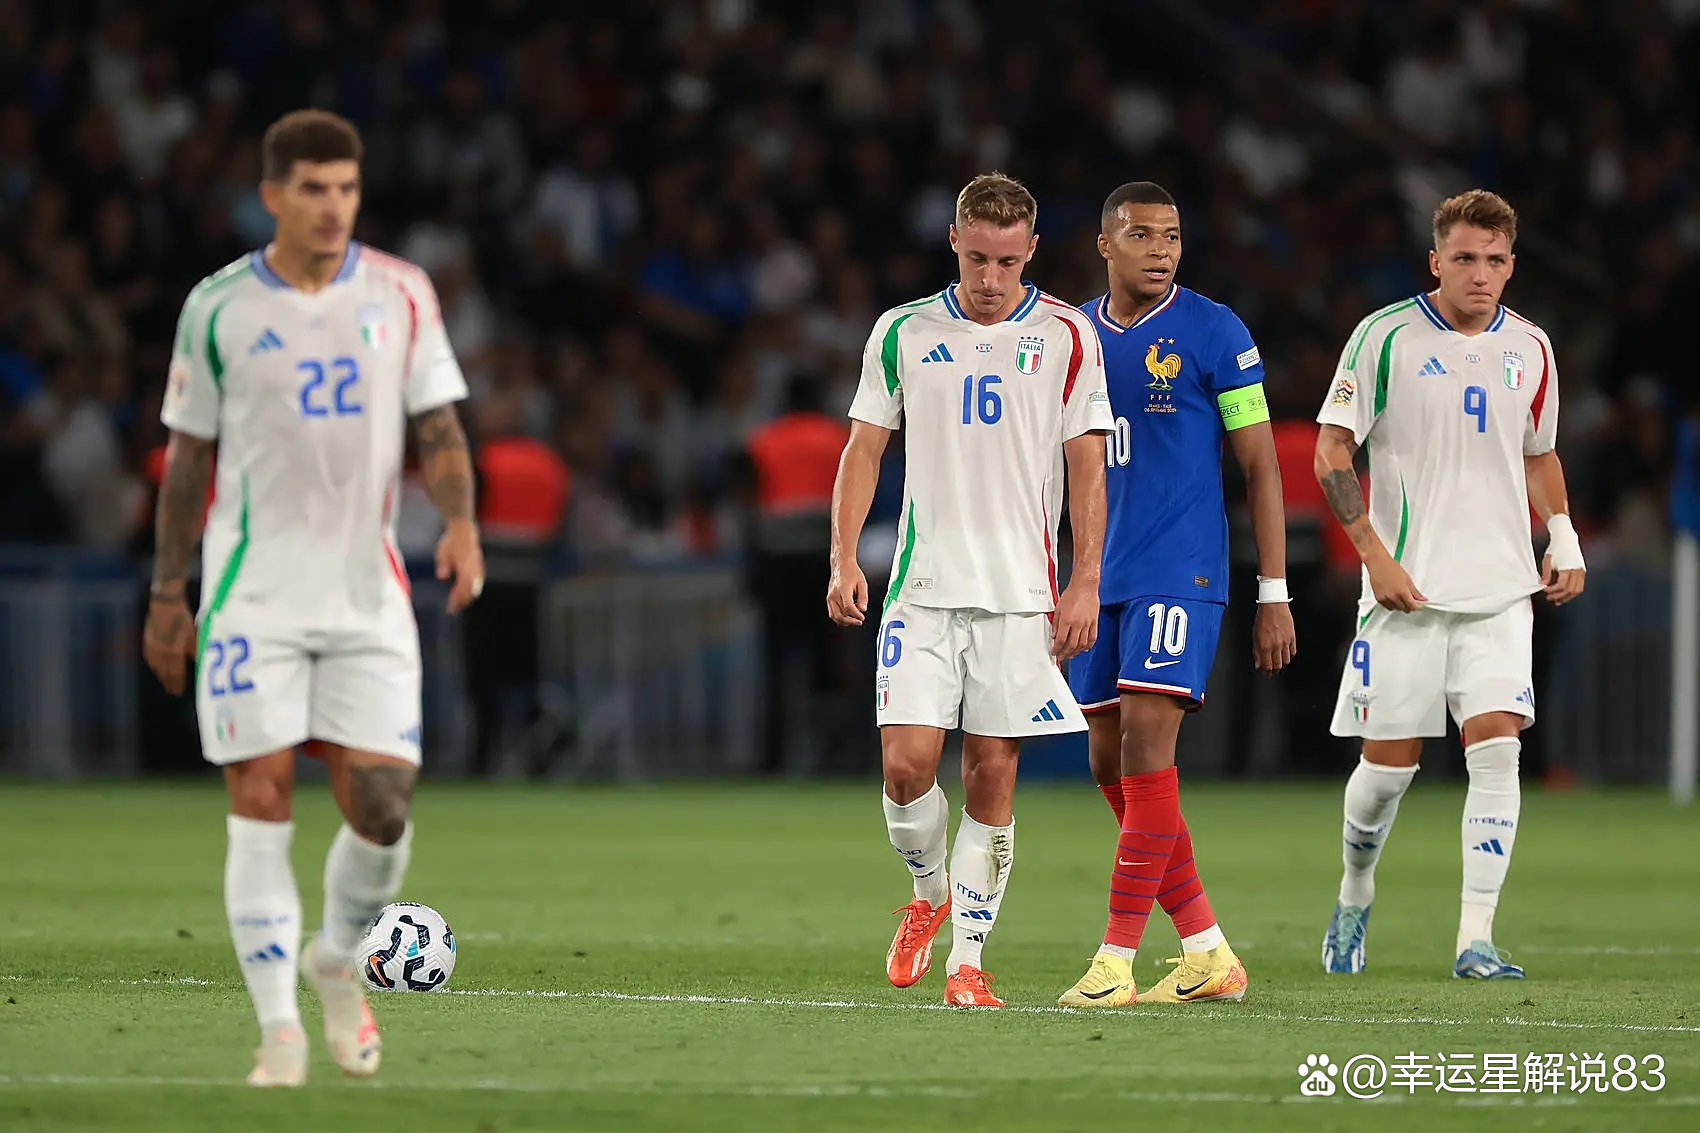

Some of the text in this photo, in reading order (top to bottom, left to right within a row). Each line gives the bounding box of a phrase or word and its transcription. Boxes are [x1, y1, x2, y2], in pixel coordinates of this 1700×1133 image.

[297, 356, 363, 417] 22
[962, 374, 1003, 425] 16
[1464, 385, 1487, 433] 9
[1105, 416, 1131, 468] 10
[1148, 603, 1189, 656] 10
[206, 636, 254, 697] 22
[1352, 640, 1370, 687] 9
[1468, 816, 1514, 829] ITALIA
[956, 882, 998, 903] ITALIA
